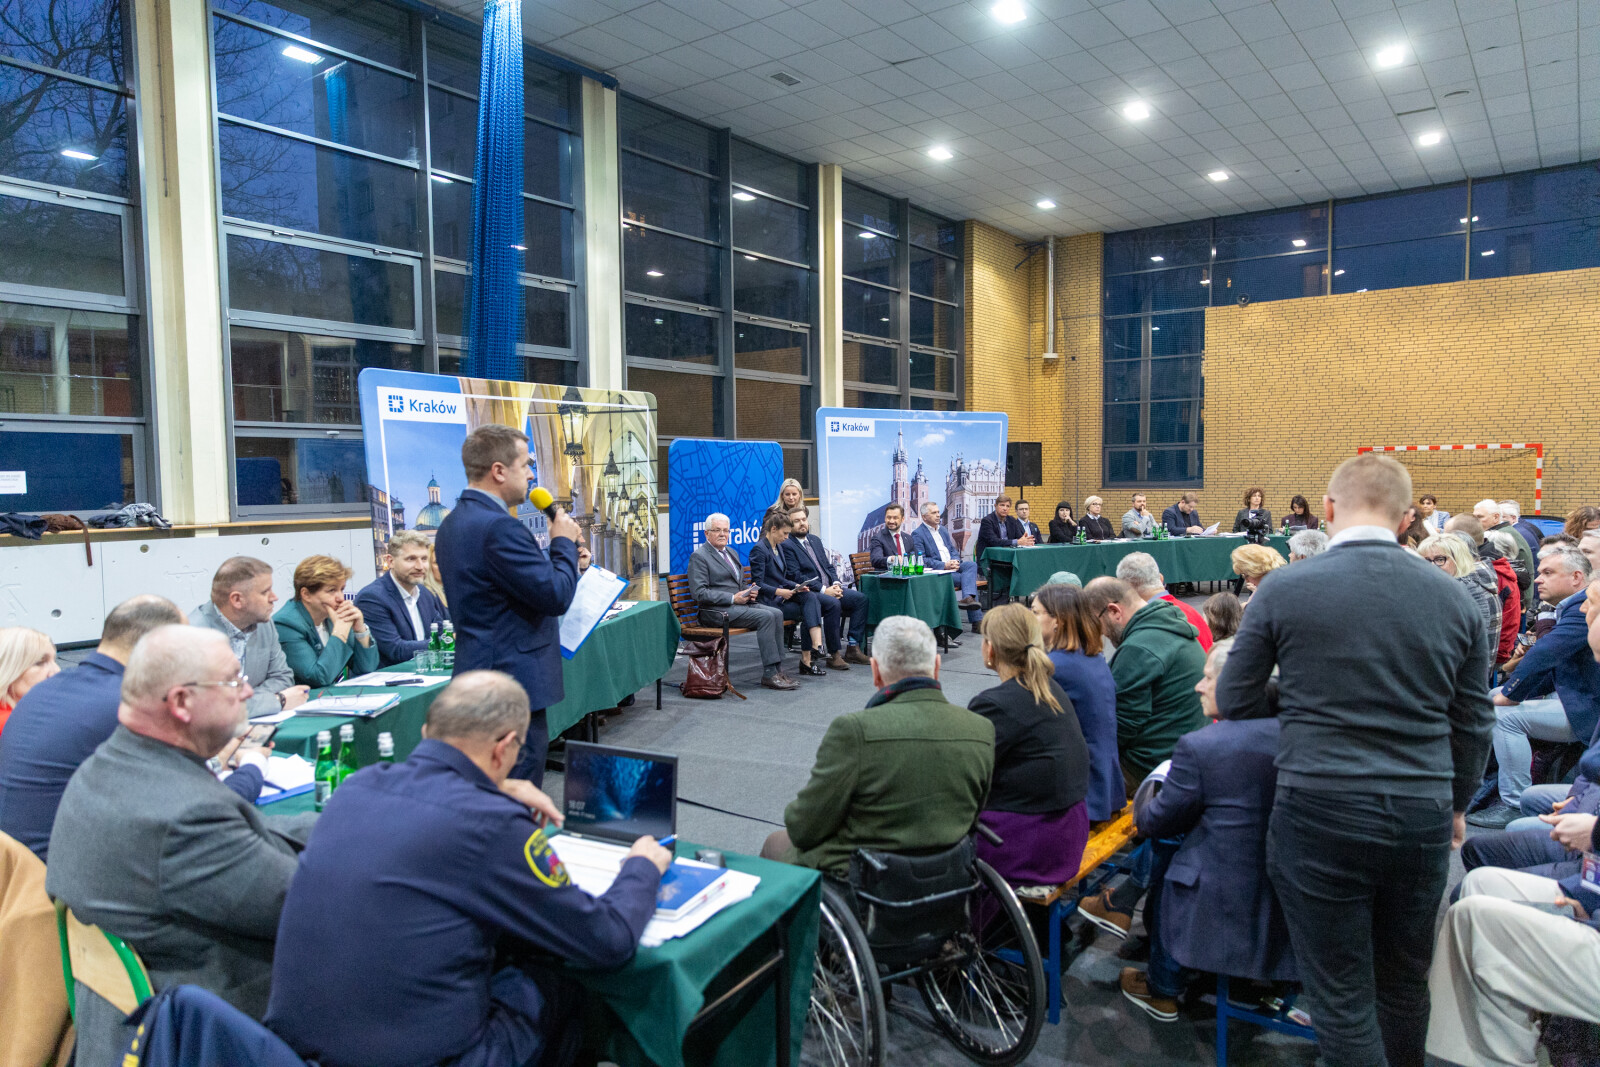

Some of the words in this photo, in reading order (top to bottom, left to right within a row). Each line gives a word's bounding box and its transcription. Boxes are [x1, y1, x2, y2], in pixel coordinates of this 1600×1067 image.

[409, 398, 457, 415] Kraków
[842, 422, 870, 432] Kraków
[727, 519, 762, 546] rakó
